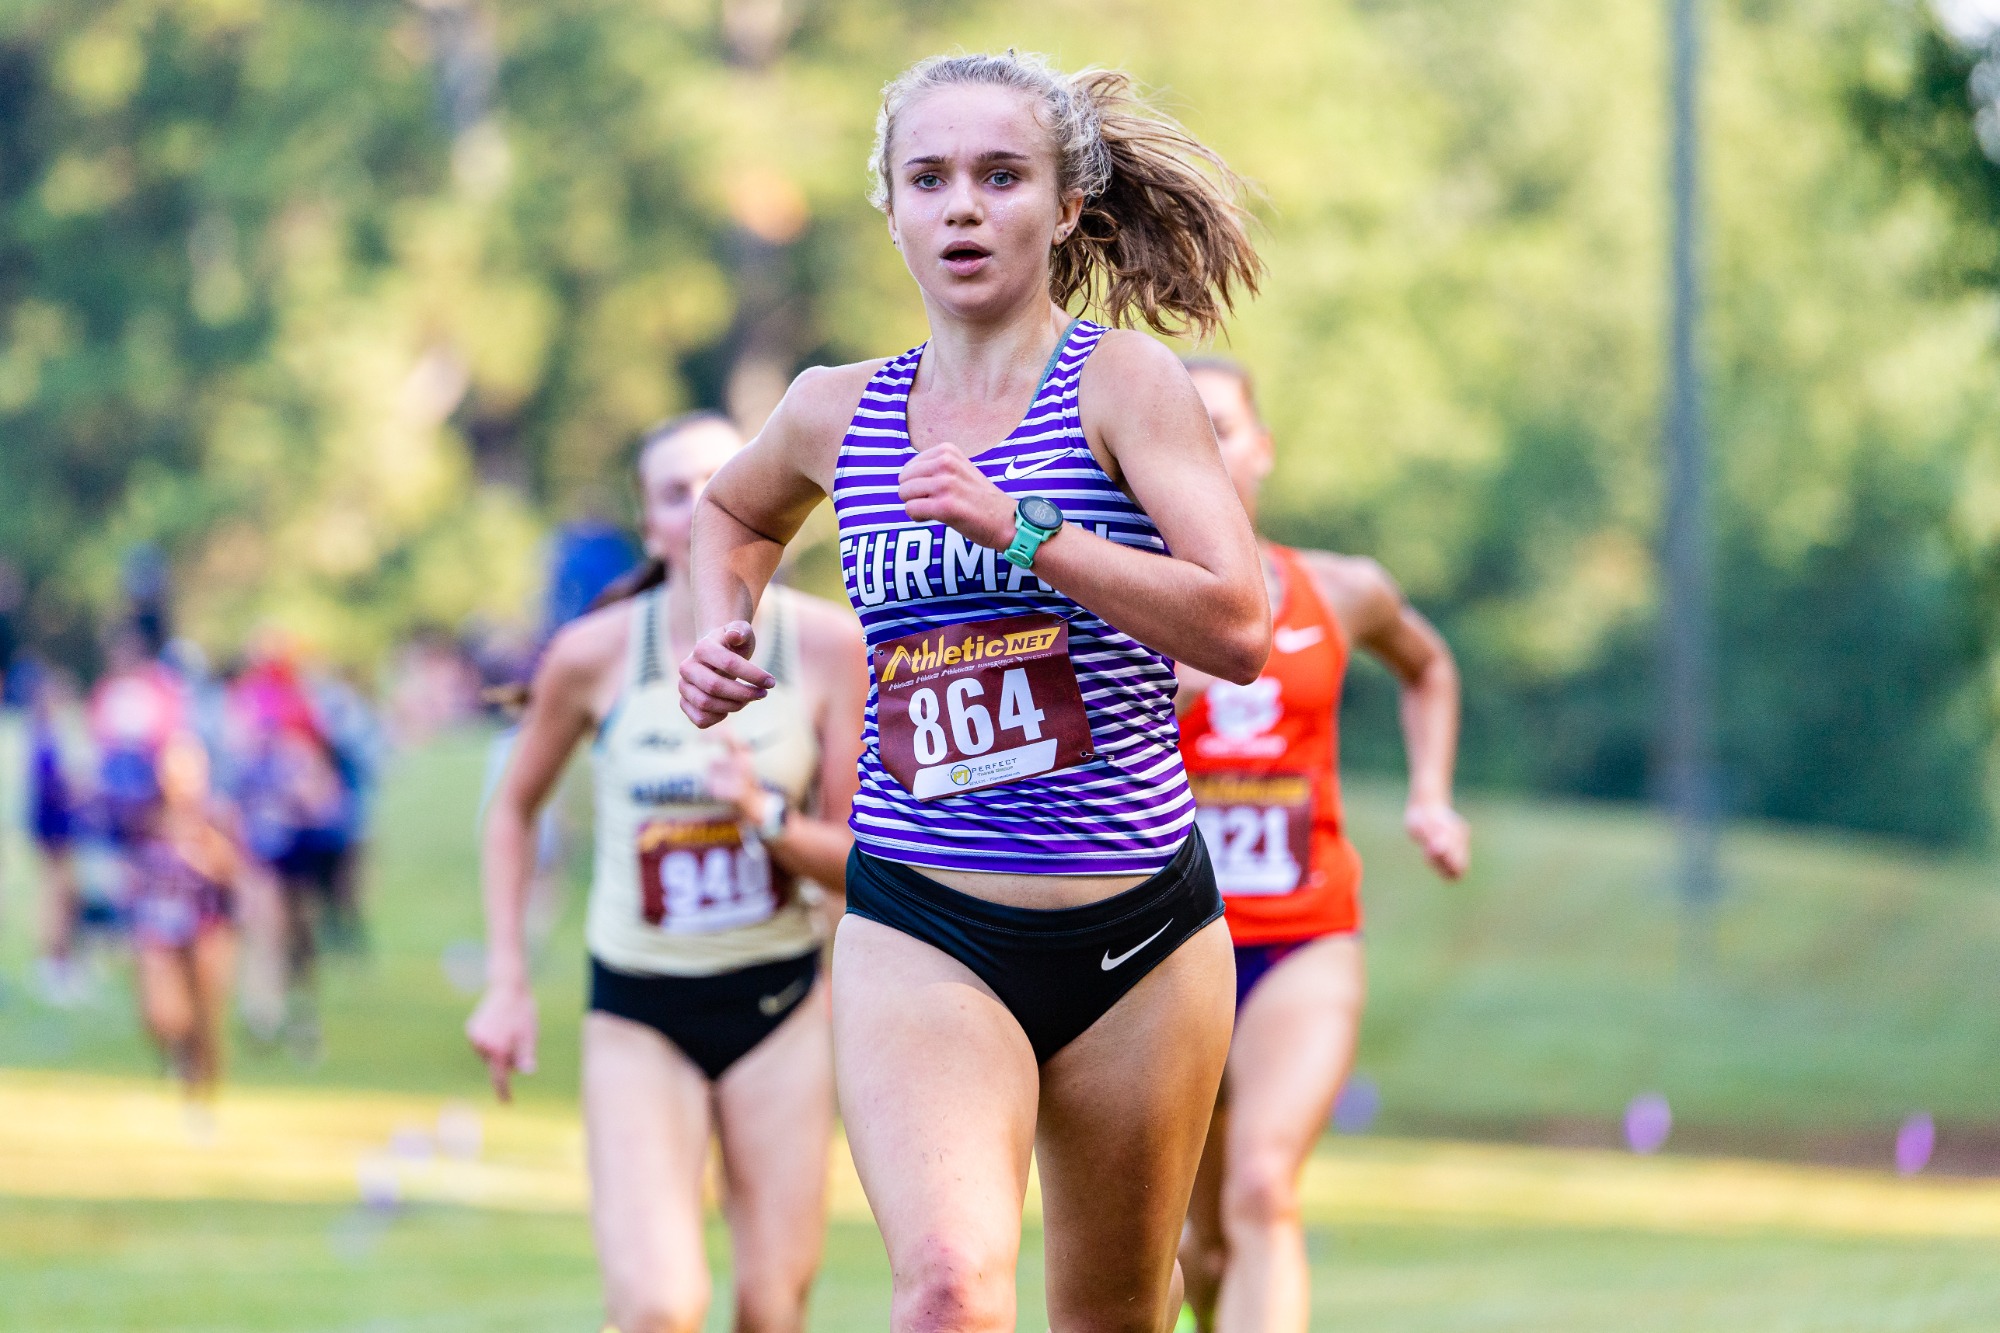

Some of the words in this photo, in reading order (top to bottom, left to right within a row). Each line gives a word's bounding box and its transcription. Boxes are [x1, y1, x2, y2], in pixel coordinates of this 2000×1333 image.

[839, 522, 1110, 607] FURM
[908, 667, 1046, 765] 864
[971, 757, 1017, 773] PERFECT
